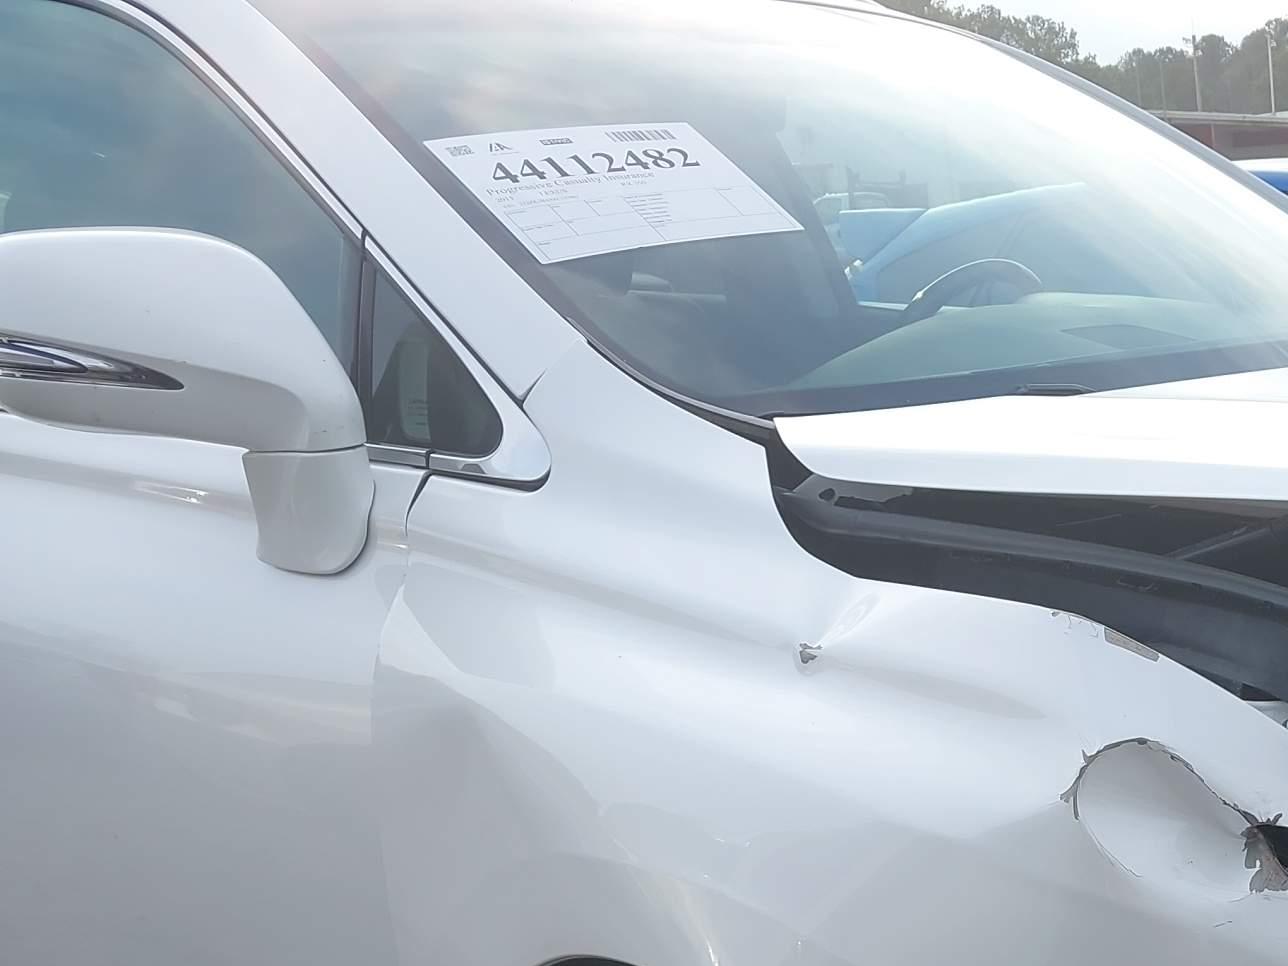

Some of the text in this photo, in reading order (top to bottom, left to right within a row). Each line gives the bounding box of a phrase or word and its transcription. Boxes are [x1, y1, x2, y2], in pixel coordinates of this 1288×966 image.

[492, 147, 701, 184] 44112482
[486, 172, 655, 195] Progressive Casualty Insurance
